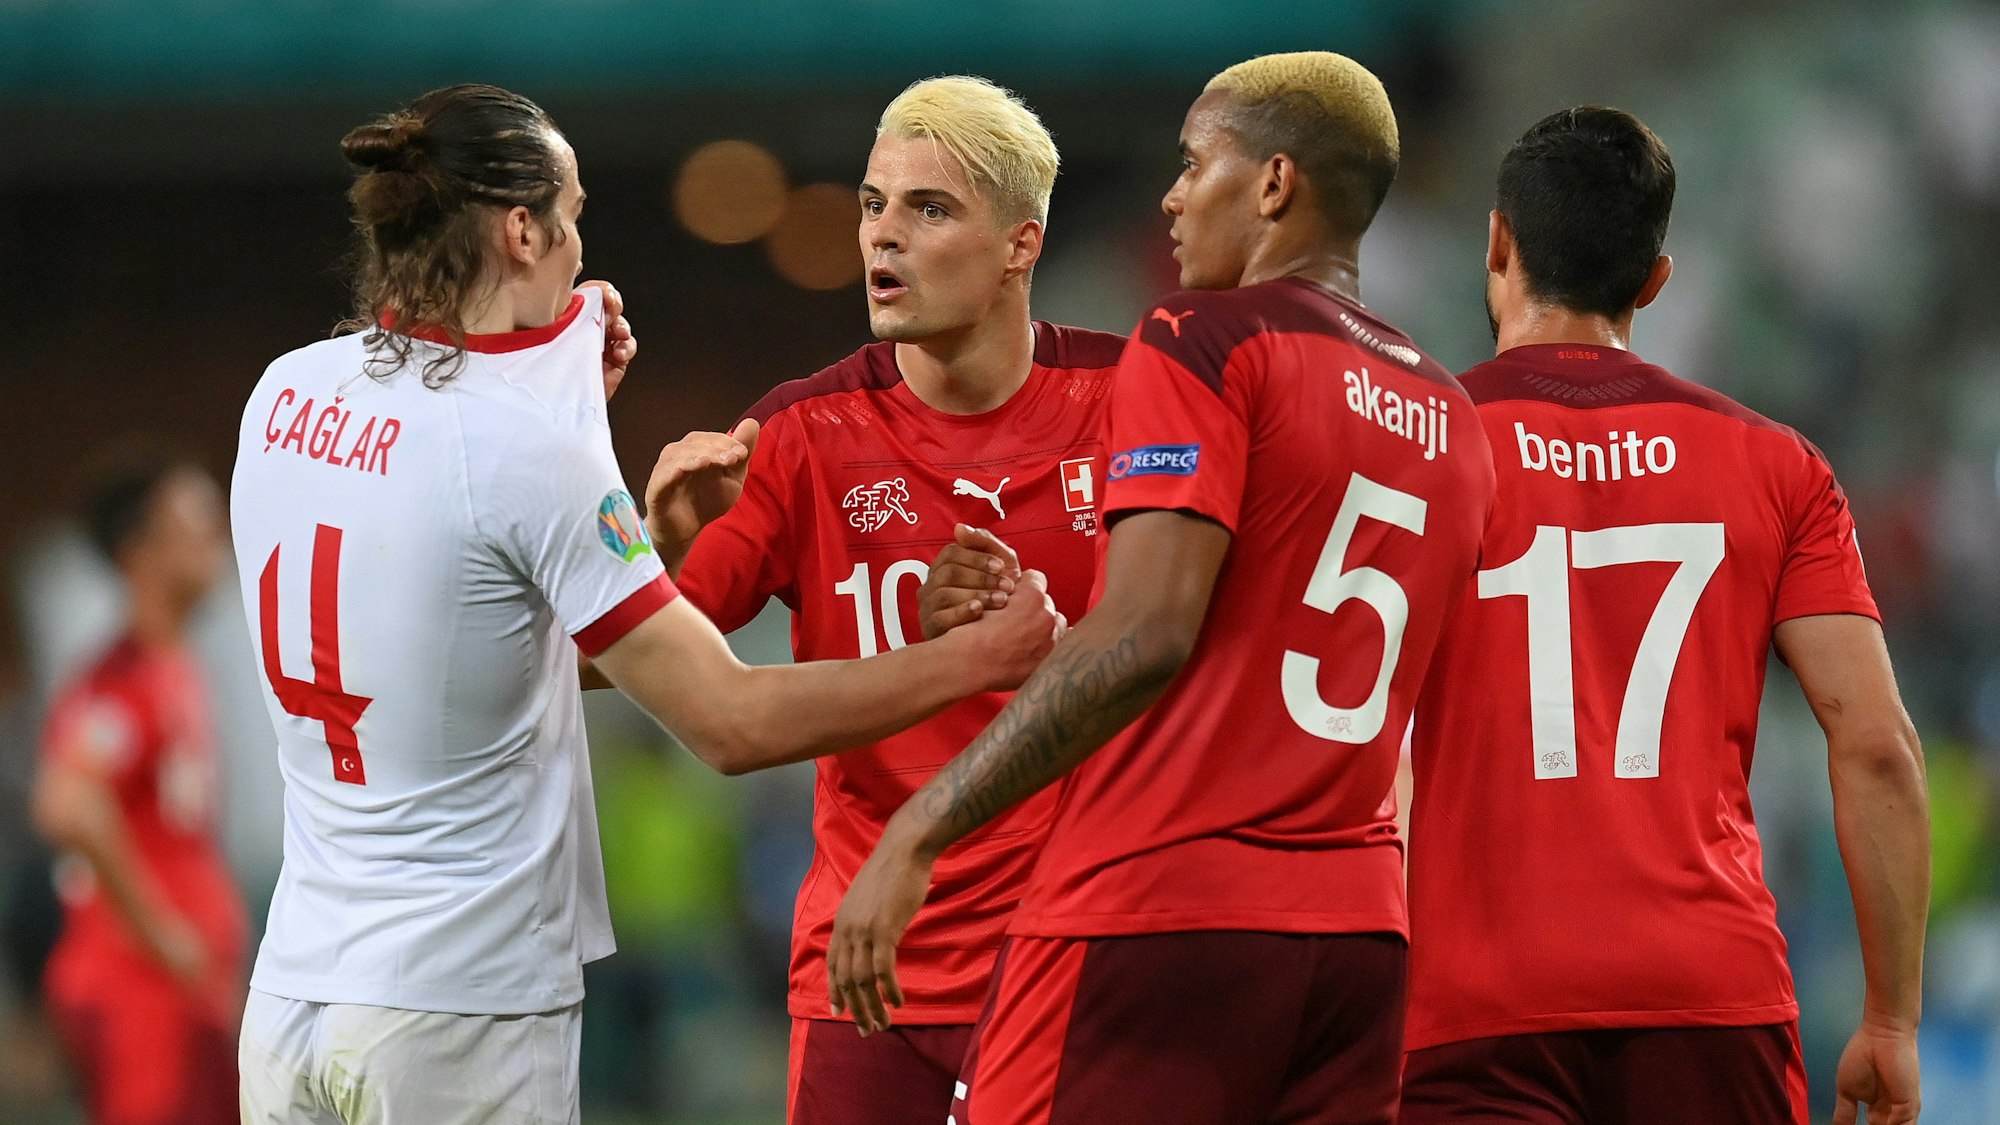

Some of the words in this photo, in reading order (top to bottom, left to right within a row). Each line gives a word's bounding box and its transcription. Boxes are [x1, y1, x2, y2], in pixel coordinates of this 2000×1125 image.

[1557, 350, 1599, 361] suisse
[265, 387, 402, 476] ÇAĞLAR
[1343, 367, 1449, 462] akanji
[1513, 421, 1678, 483] benito
[1131, 450, 1199, 468] RESPECT
[1072, 519, 1087, 531] SUI
[1075, 512, 1095, 521] 20.06.2
[1281, 472, 1428, 744] 5
[259, 523, 374, 787] 4
[1476, 522, 1727, 781] 17
